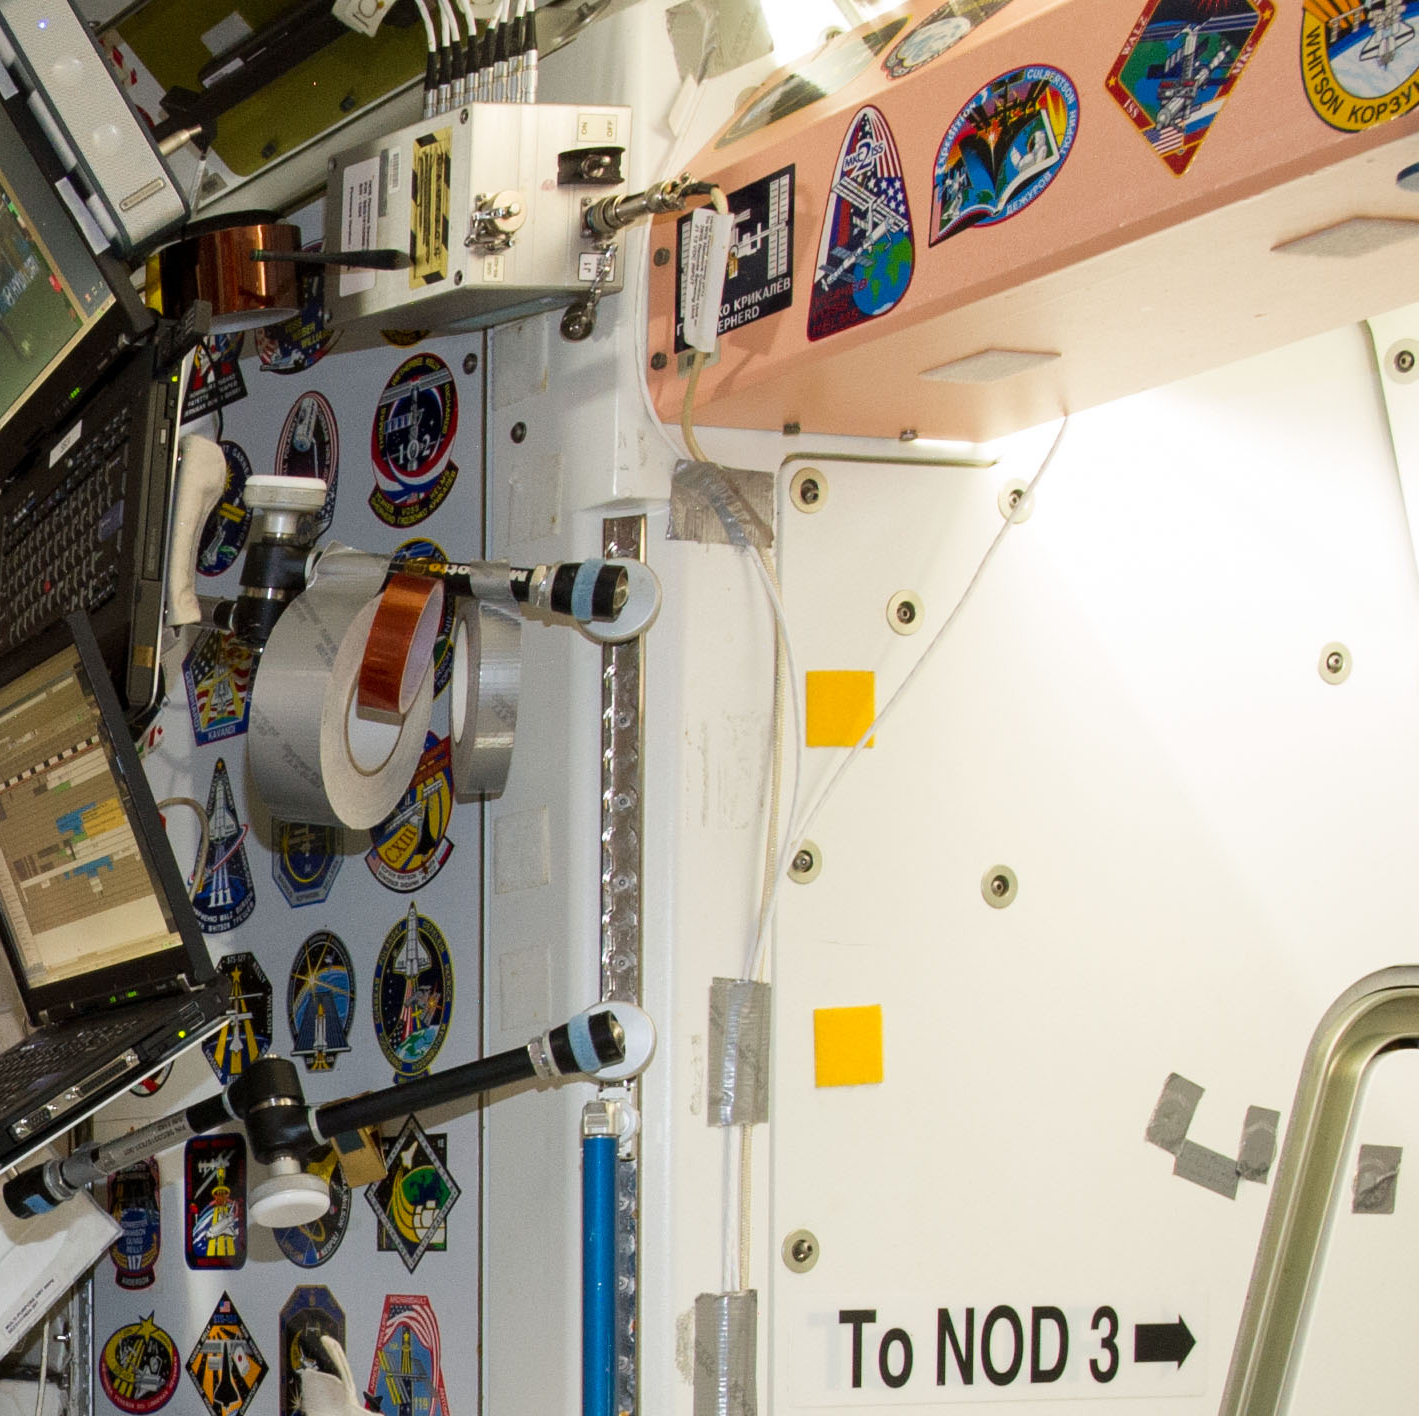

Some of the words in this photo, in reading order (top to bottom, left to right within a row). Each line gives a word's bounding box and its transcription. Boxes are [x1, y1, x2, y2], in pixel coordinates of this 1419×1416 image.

[1121, 15, 1148, 56] WALZ
[1027, 68, 1076, 104] CULBERTSON
[1304, 25, 1344, 116] WHITSON
[580, 121, 588, 135] ON
[605, 120, 613, 138] OFF
[871, 142, 885, 156] ISS
[582, 262, 592, 273] J1
[734, 276, 792, 310] КРИКАЛЁВ
[717, 304, 761, 334] EPHERD
[398, 433, 432, 466] 102
[839, 1309, 913, 1390] To
[937, 1305, 1069, 1387] NOD
[1089, 1305, 1120, 1384] 3
